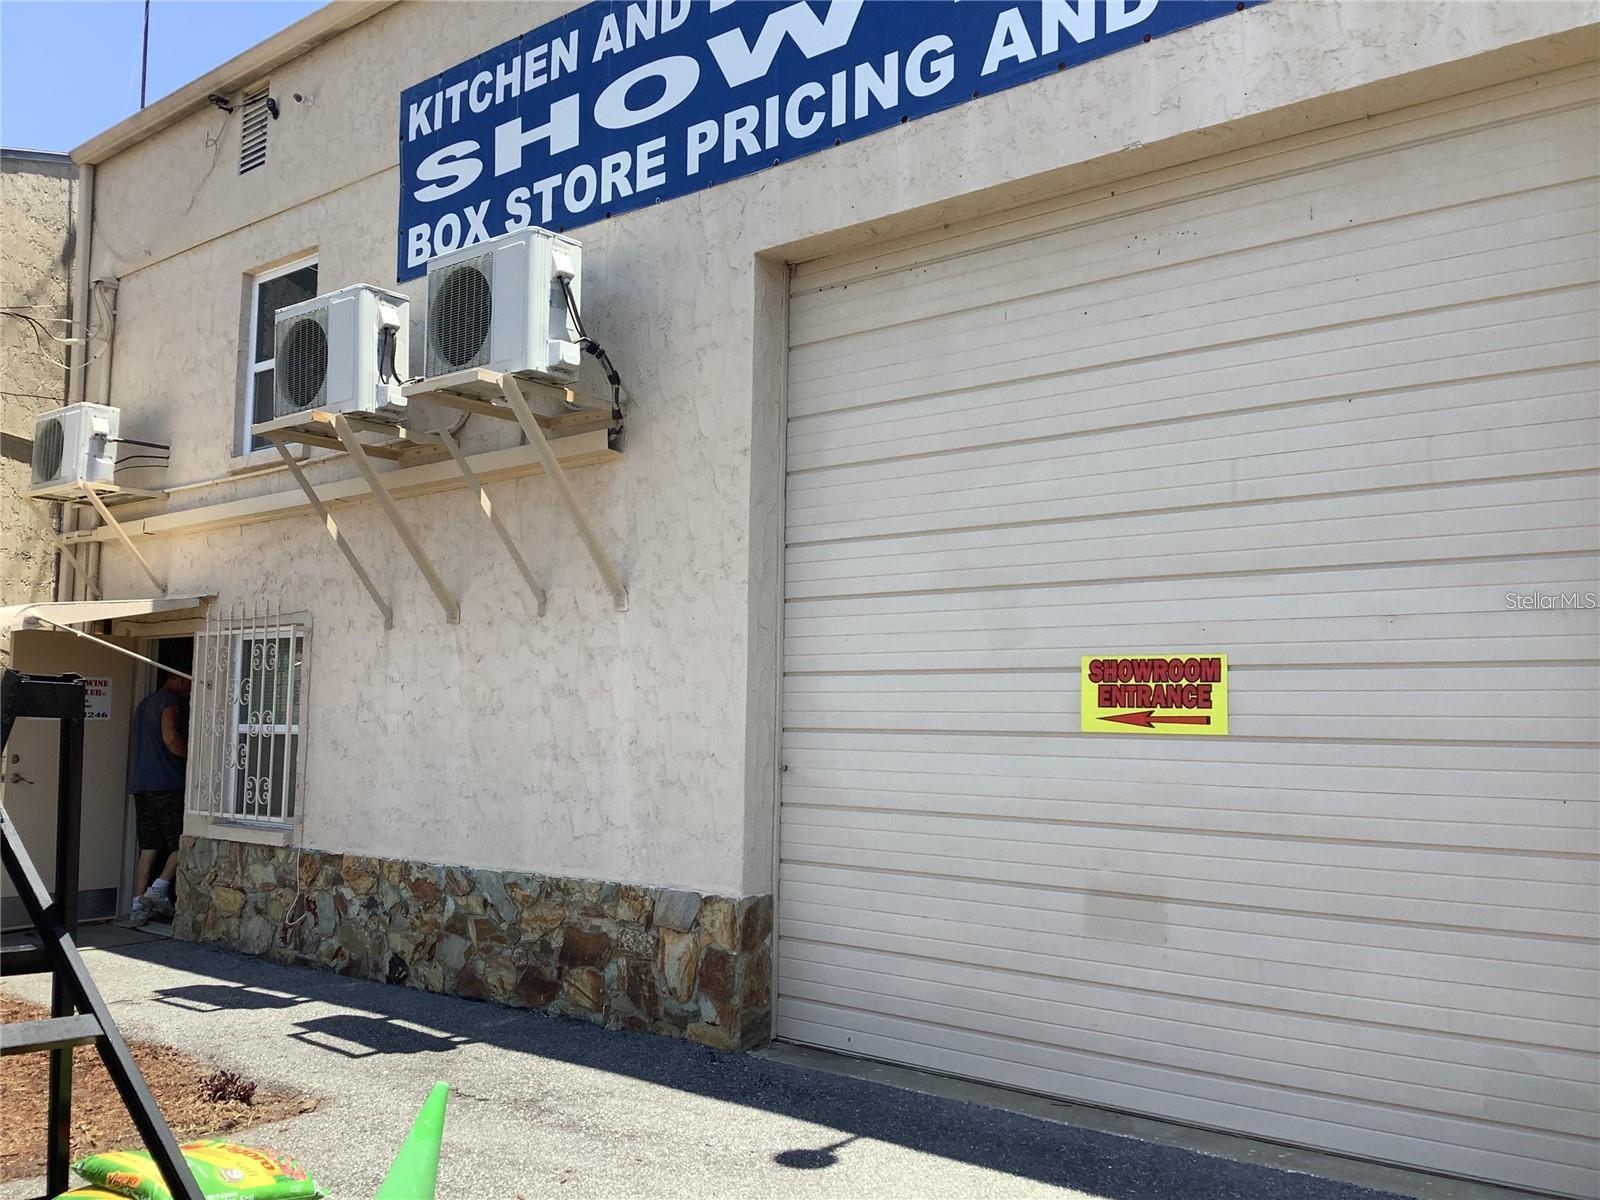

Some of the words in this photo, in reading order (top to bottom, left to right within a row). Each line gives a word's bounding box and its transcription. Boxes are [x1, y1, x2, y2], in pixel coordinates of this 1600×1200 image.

[407, 199, 491, 268] BOX
[505, 136, 666, 235] STORE
[687, 34, 955, 176] PRICING
[980, 0, 1160, 77] AND
[408, 29, 579, 141] KITCHEN
[592, 0, 692, 63] AND
[413, 0, 865, 202] SHOW
[1088, 657, 1221, 683] SHOWROOM
[1098, 684, 1212, 709] ENTRANCE
